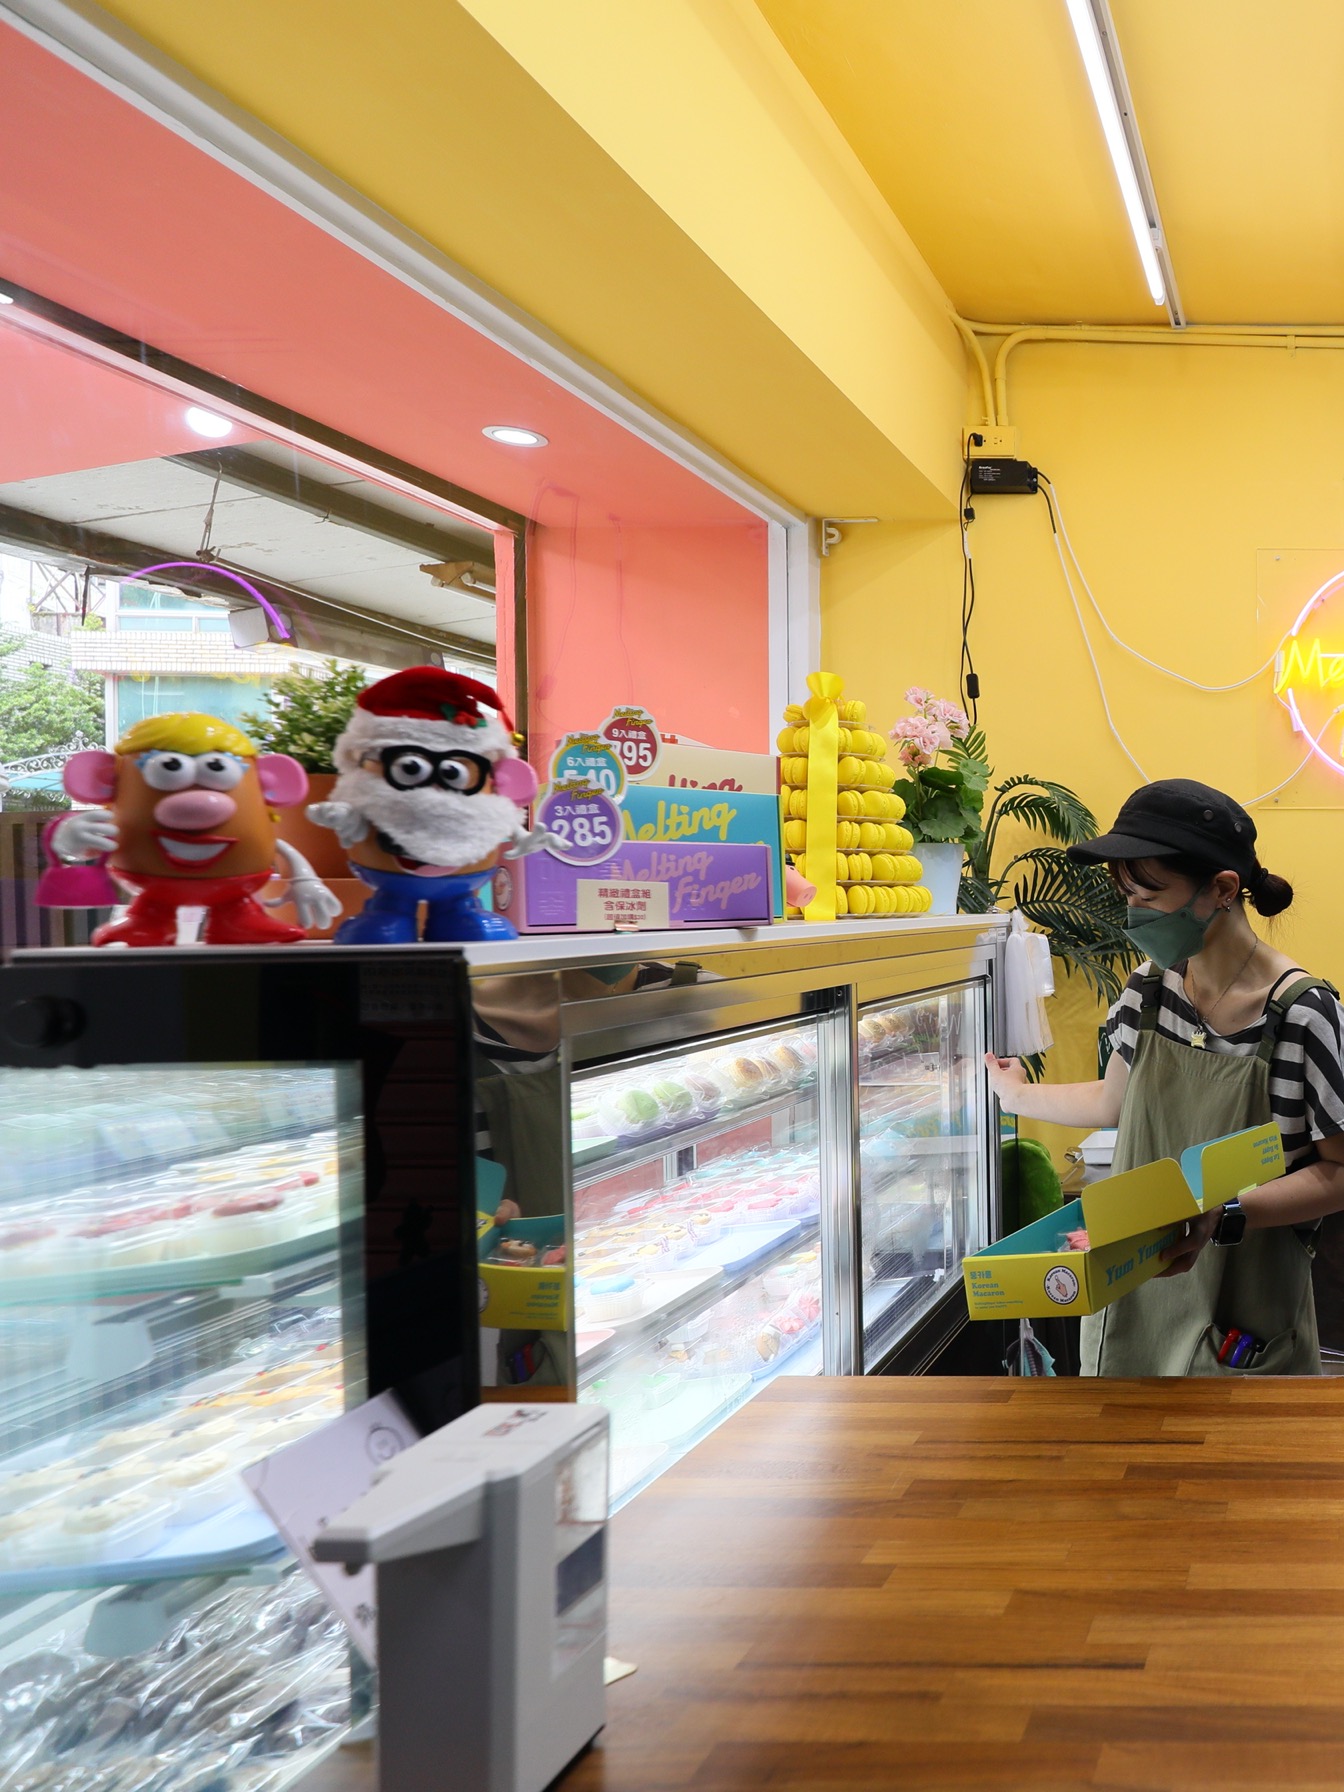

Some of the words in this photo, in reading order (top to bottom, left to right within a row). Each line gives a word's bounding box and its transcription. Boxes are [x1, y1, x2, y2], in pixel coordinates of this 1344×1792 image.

[611, 728, 647, 740] 9入禮盒
[554, 803, 600, 816] 3入禮盒
[551, 816, 612, 847] 285
[671, 872, 762, 913] Finger
